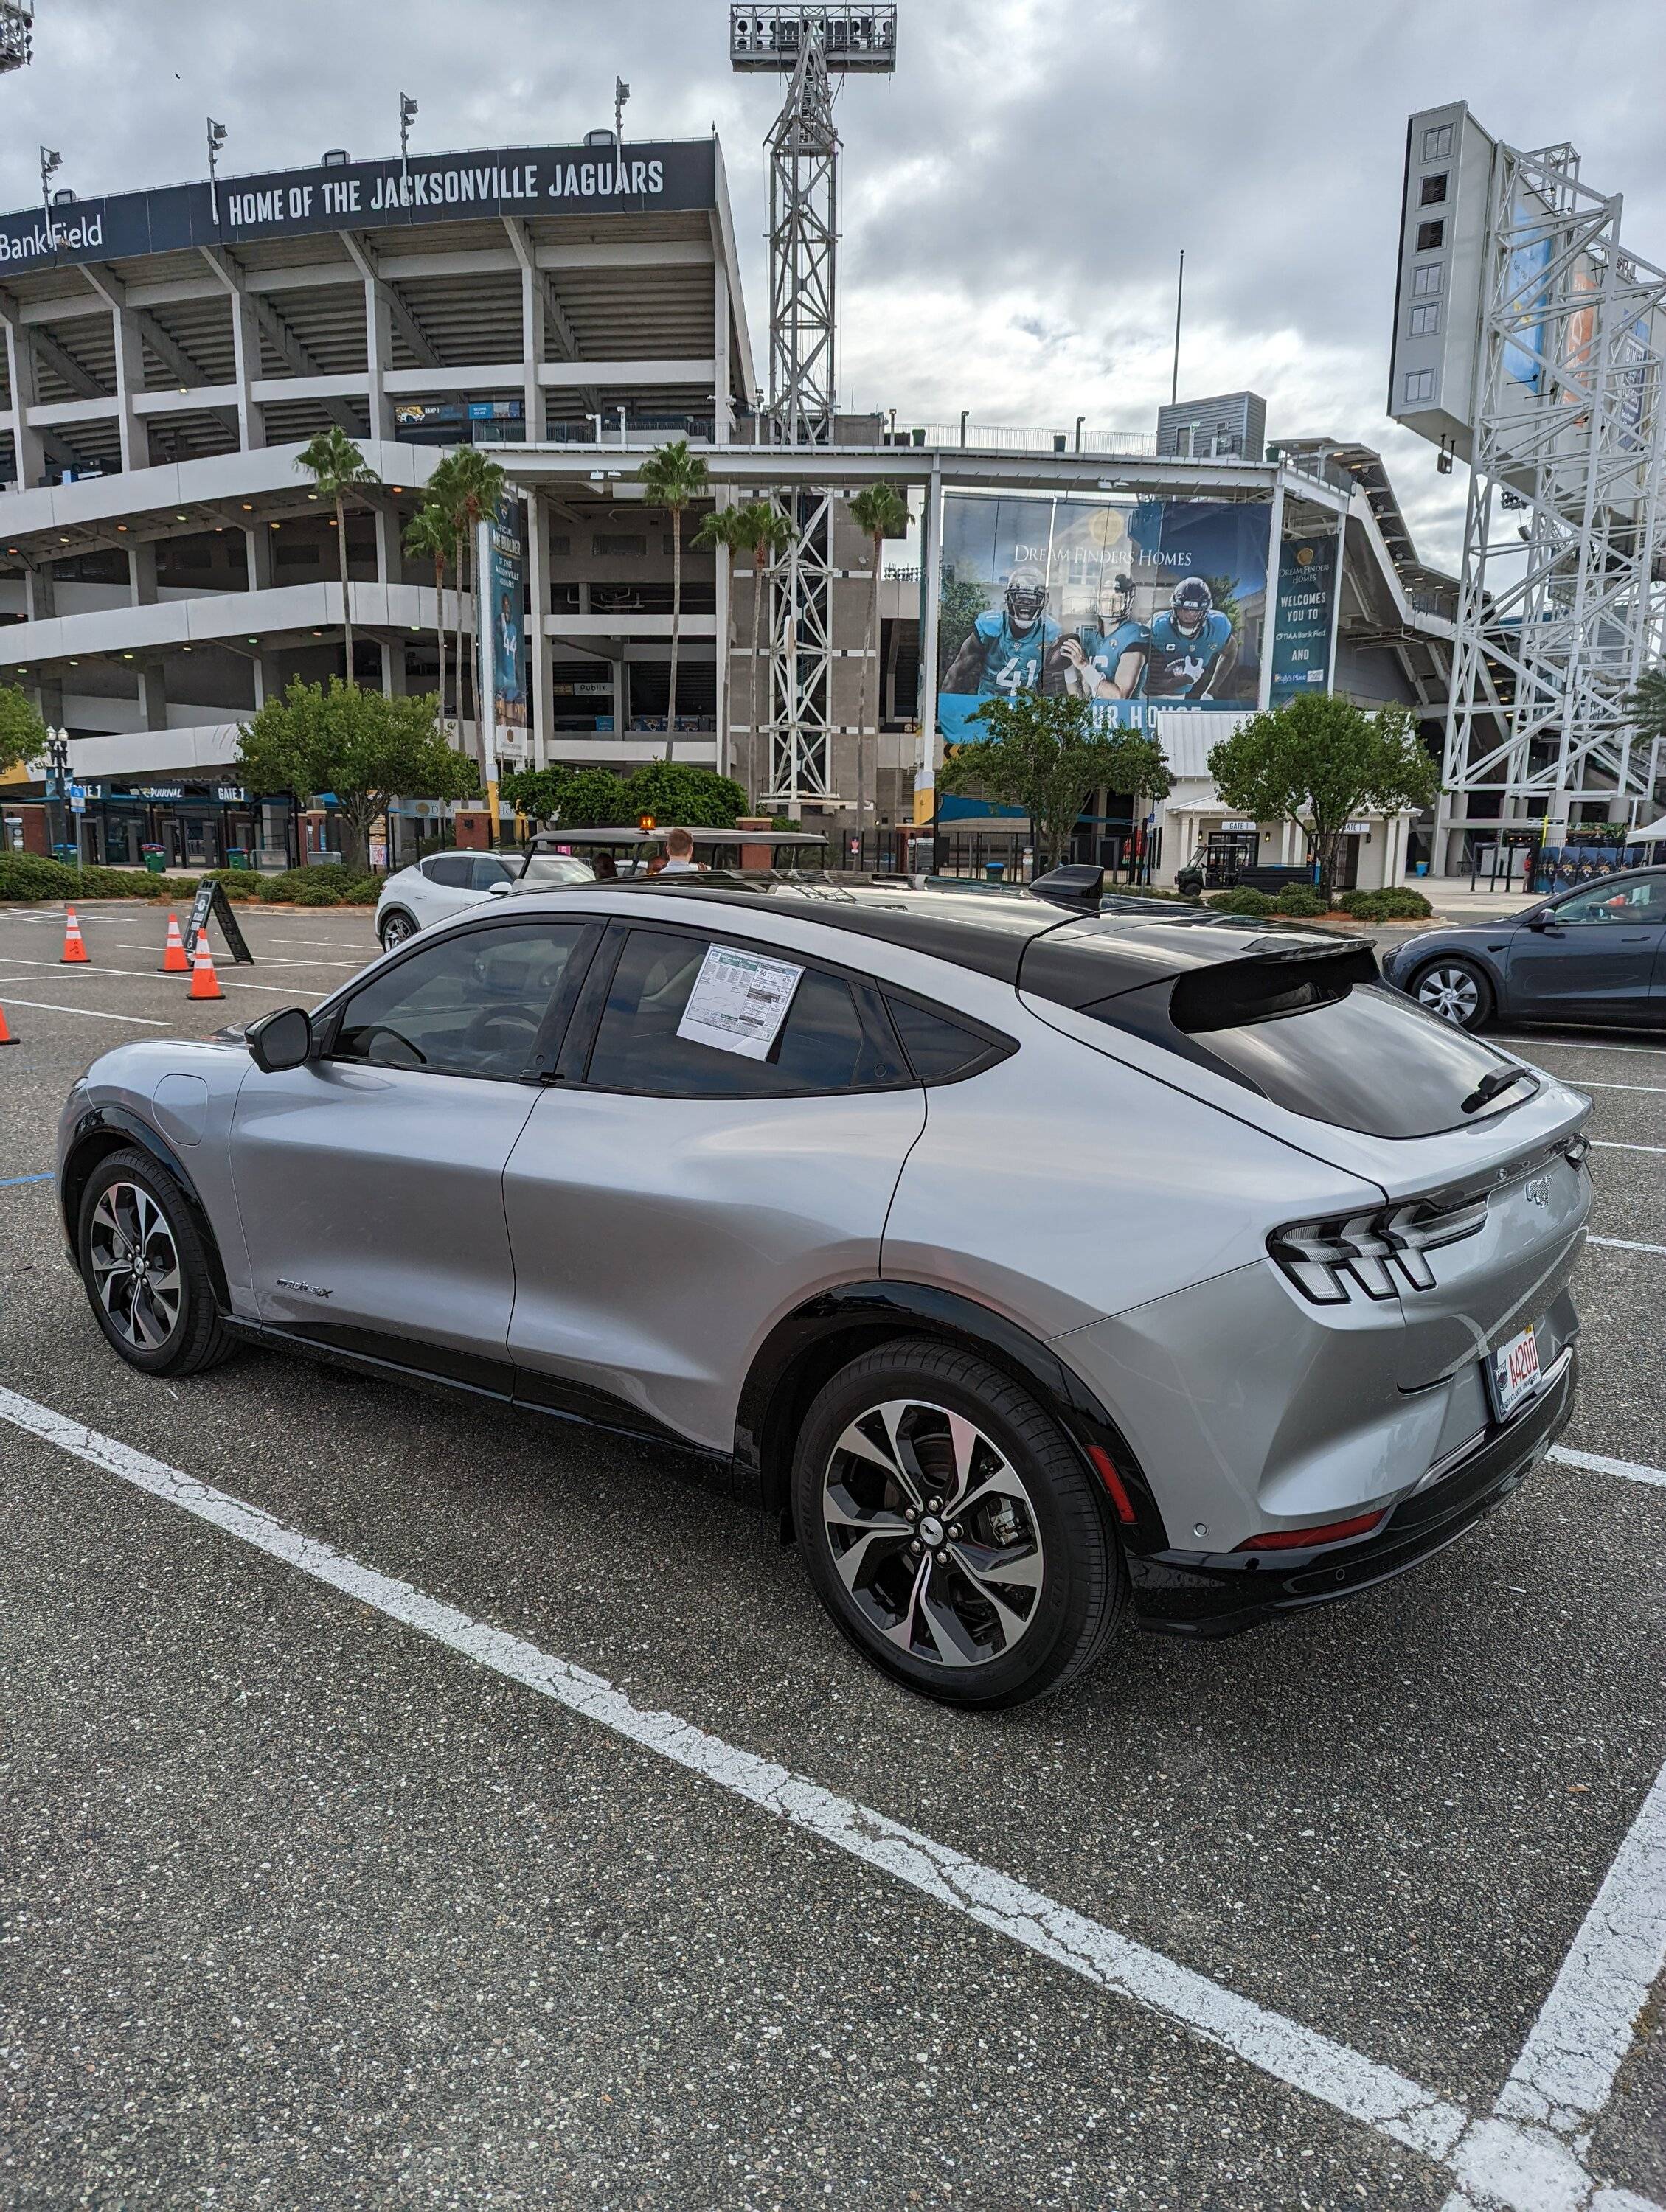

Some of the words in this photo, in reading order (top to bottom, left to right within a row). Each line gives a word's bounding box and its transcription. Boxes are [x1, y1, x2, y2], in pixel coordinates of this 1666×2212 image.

[229, 193, 283, 226] HOME
[289, 186, 313, 218] OF
[321, 180, 361, 214] THE
[370, 164, 538, 209] JACKSONVILLE
[549, 161, 663, 197] JAGUARS
[1014, 545, 1069, 563] DREAM
[1074, 547, 1134, 565] FINDERS
[1139, 549, 1192, 566] HOMES
[1303, 564, 1330, 574] FINDERS
[1293, 574, 1316, 584] HOMES
[1281, 592, 1326, 608] WELCOMES
[1287, 610, 1304, 622] YOU
[1308, 608, 1319, 620] TO
[1298, 630, 1313, 639] Bank
[1313, 628, 1326, 637] Field
[1291, 649, 1309, 661] AND
[218, 787, 237, 800] GATE
